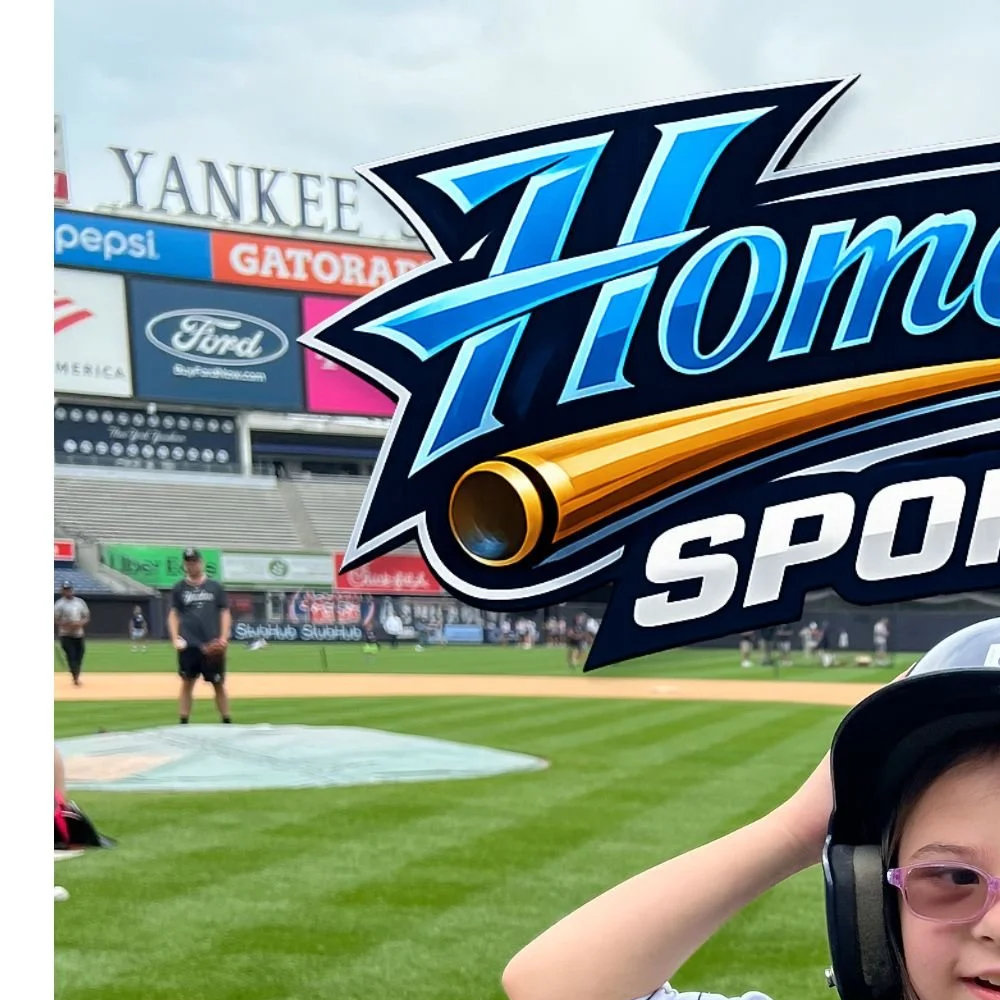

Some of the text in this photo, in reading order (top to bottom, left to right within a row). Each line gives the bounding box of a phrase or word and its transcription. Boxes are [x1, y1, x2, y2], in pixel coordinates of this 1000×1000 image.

[108, 146, 363, 235] YANKEE
[55, 223, 160, 261] pepsi
[170, 314, 263, 359] Ford
[234, 622, 363, 641] StubHub StubHub
